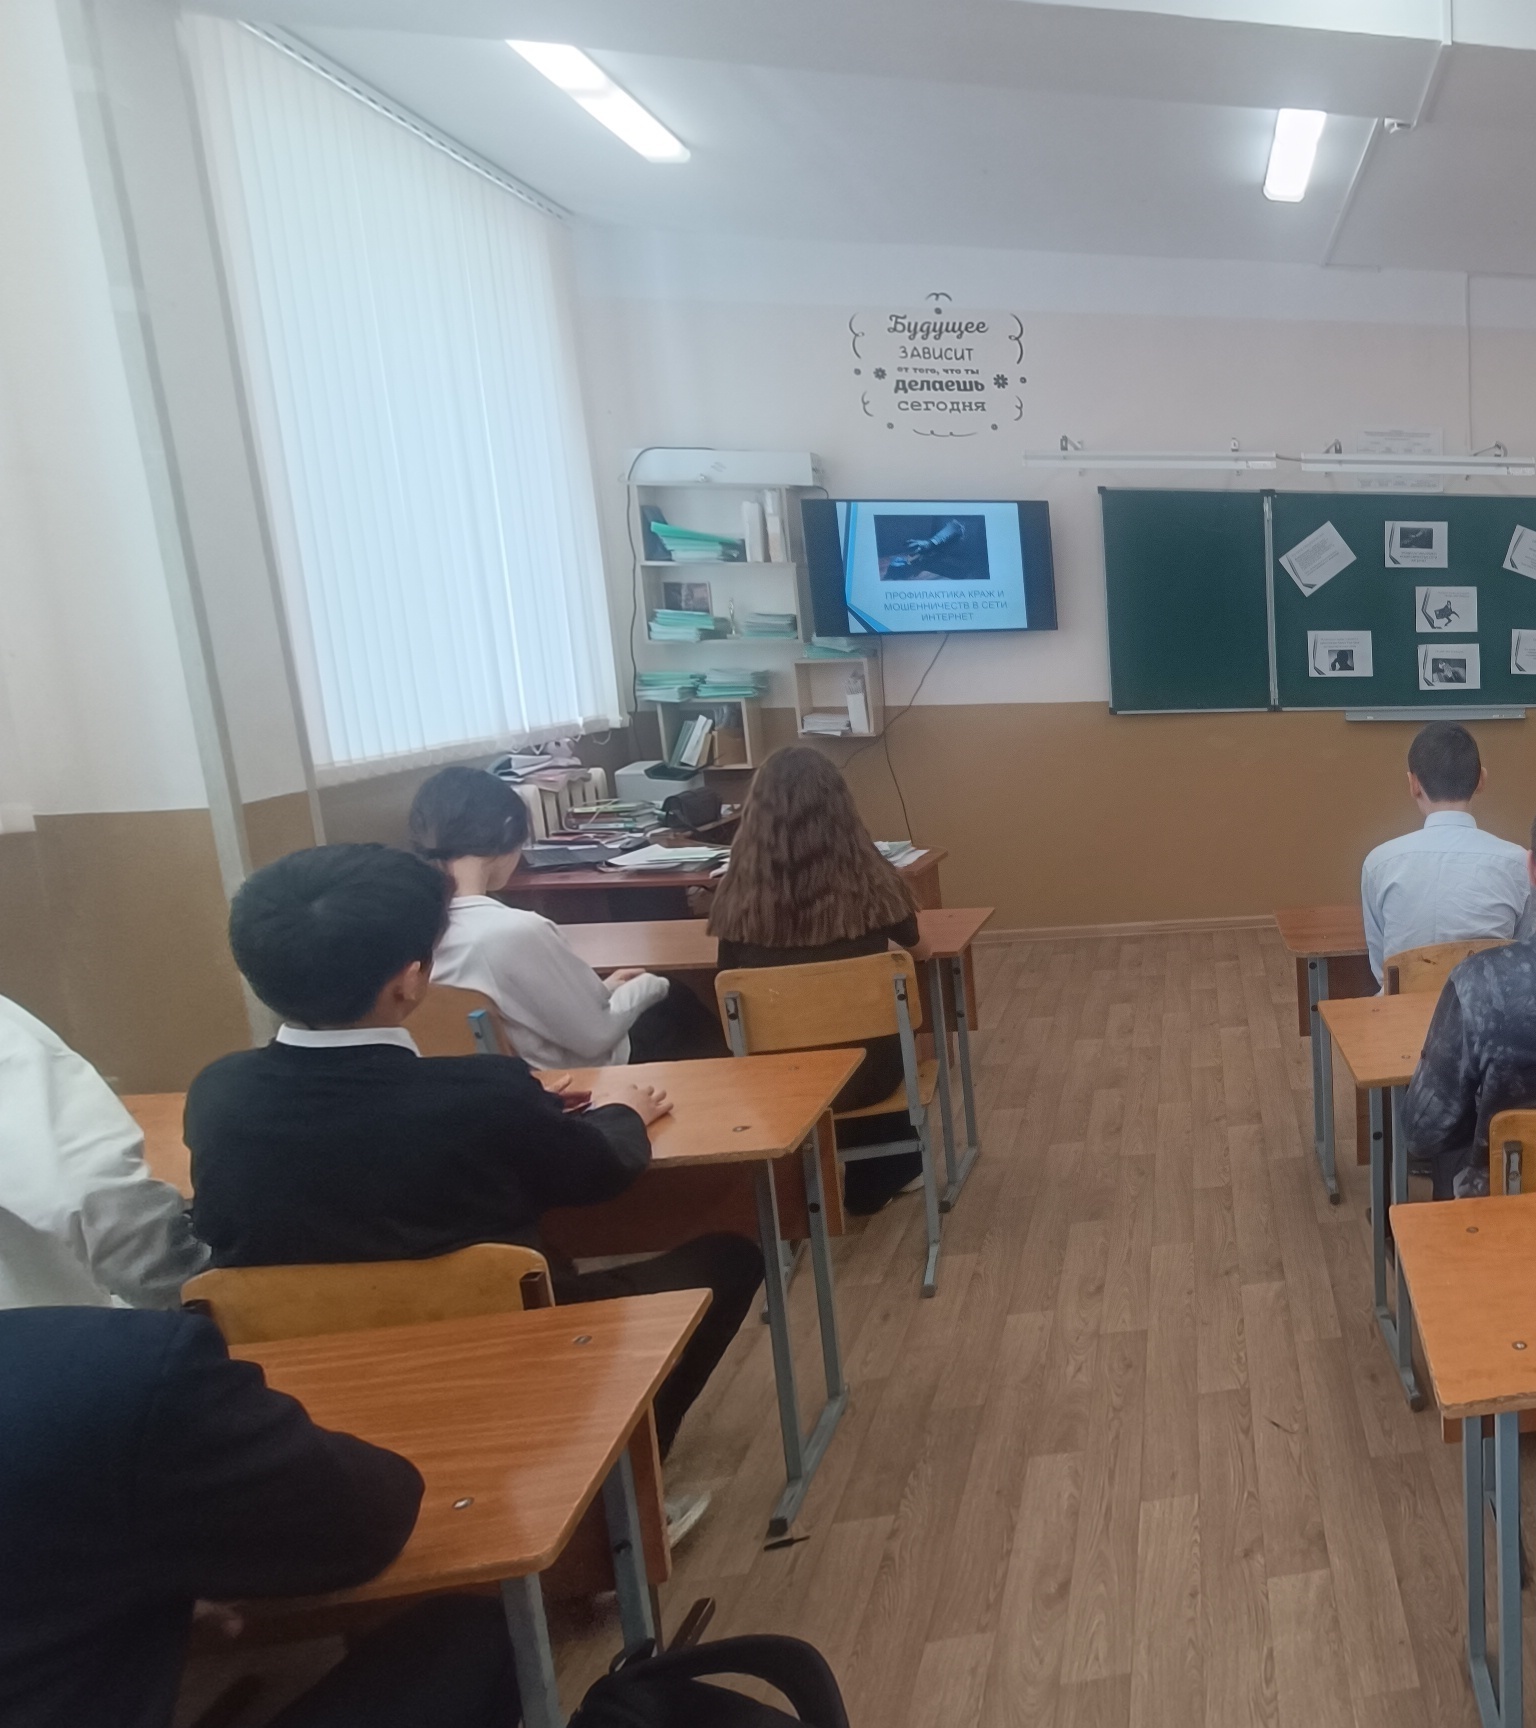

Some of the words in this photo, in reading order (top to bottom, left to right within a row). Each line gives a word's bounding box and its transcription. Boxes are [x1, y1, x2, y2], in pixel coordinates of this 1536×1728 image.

[887, 314, 989, 340] Будущее
[898, 345, 974, 361] ЗАВИСИТ
[896, 366, 909, 374] от
[912, 367, 940, 375] того,
[893, 379, 985, 394] делаешь
[897, 400, 987, 413] сегодня
[884, 590, 966, 600] ПРОФИЛАКТИКА
[968, 590, 995, 599] КРАЖ
[997, 590, 1005, 598] И
[883, 602, 970, 612] МОШЕННИЧЕСТВ
[981, 601, 1008, 609] СЕТИ
[921, 612, 974, 621] ИНТЕРНЕТ
